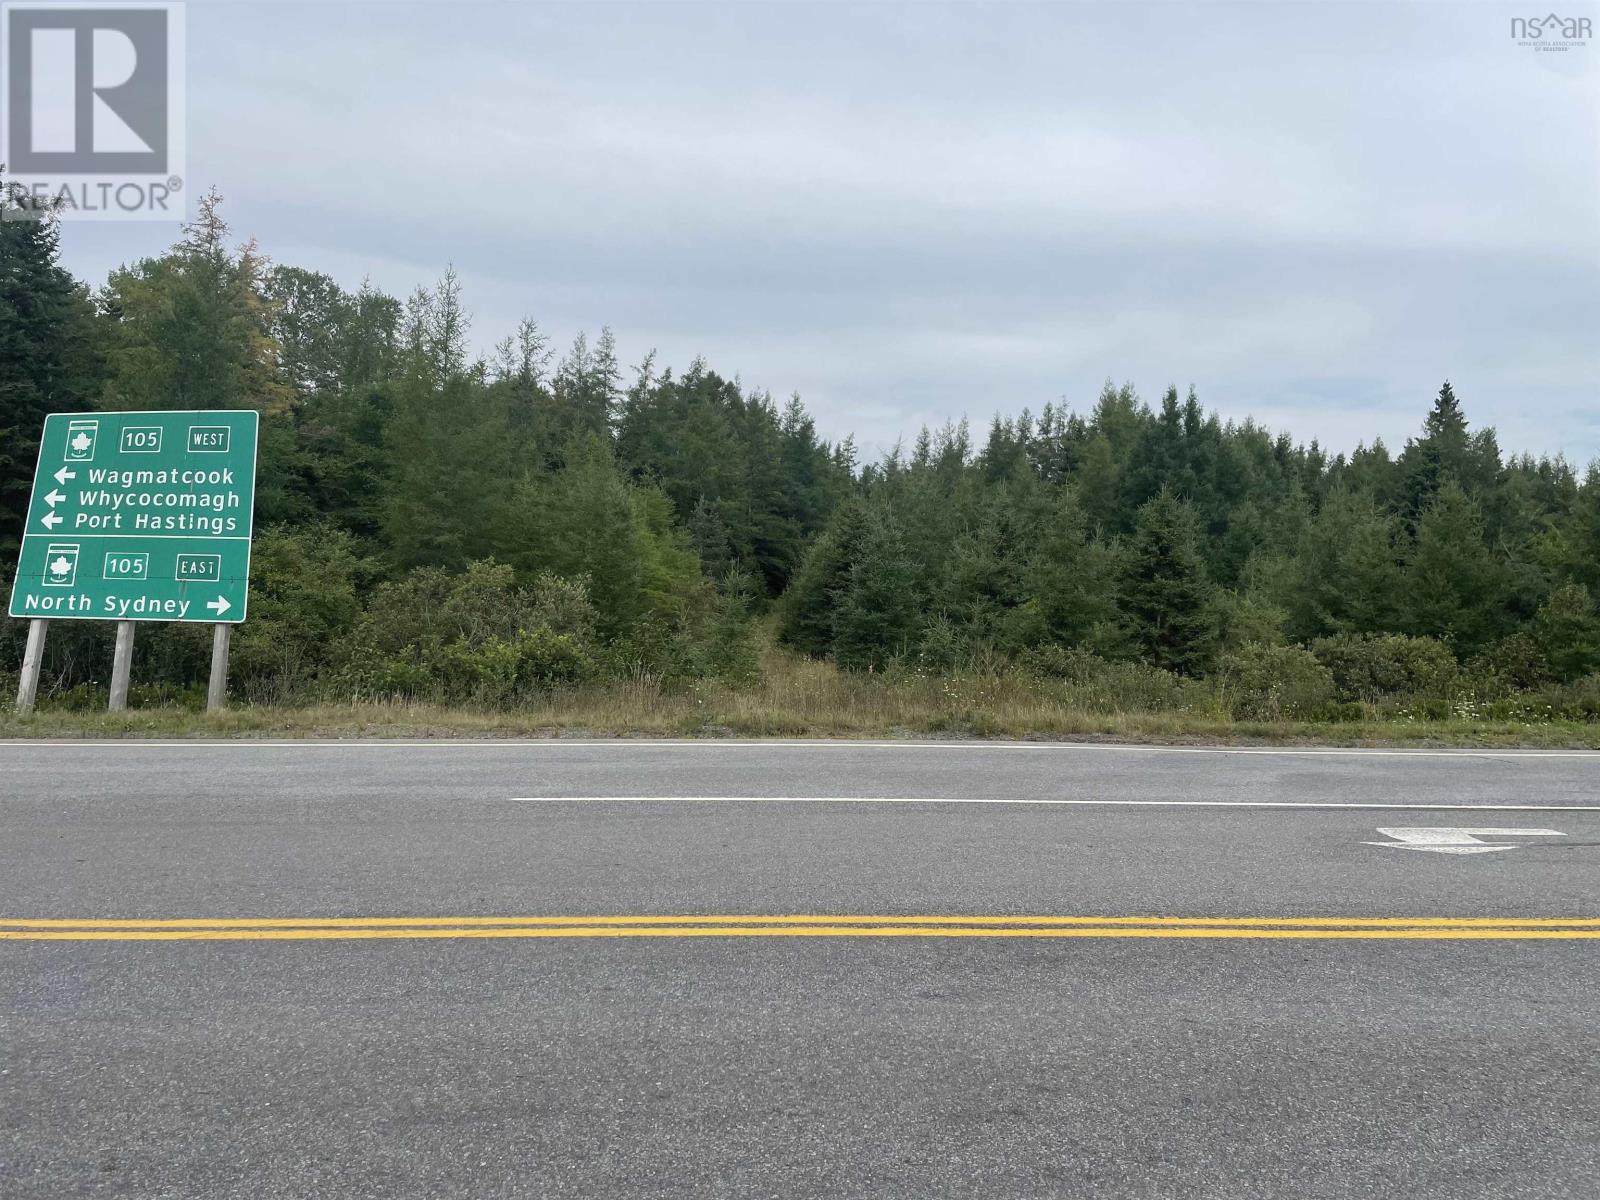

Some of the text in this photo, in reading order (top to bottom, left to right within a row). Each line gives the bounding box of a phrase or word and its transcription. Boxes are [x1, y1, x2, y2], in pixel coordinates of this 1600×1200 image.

[125, 431, 158, 447] 105
[193, 433, 224, 446] WEST
[89, 467, 234, 488] Wagmatcook
[80, 490, 240, 511] Whycocomagh
[75, 513, 237, 534] Port Hastings
[109, 558, 143, 574] 105
[181, 561, 214, 574] EAST
[25, 594, 191, 617] North Sydney
